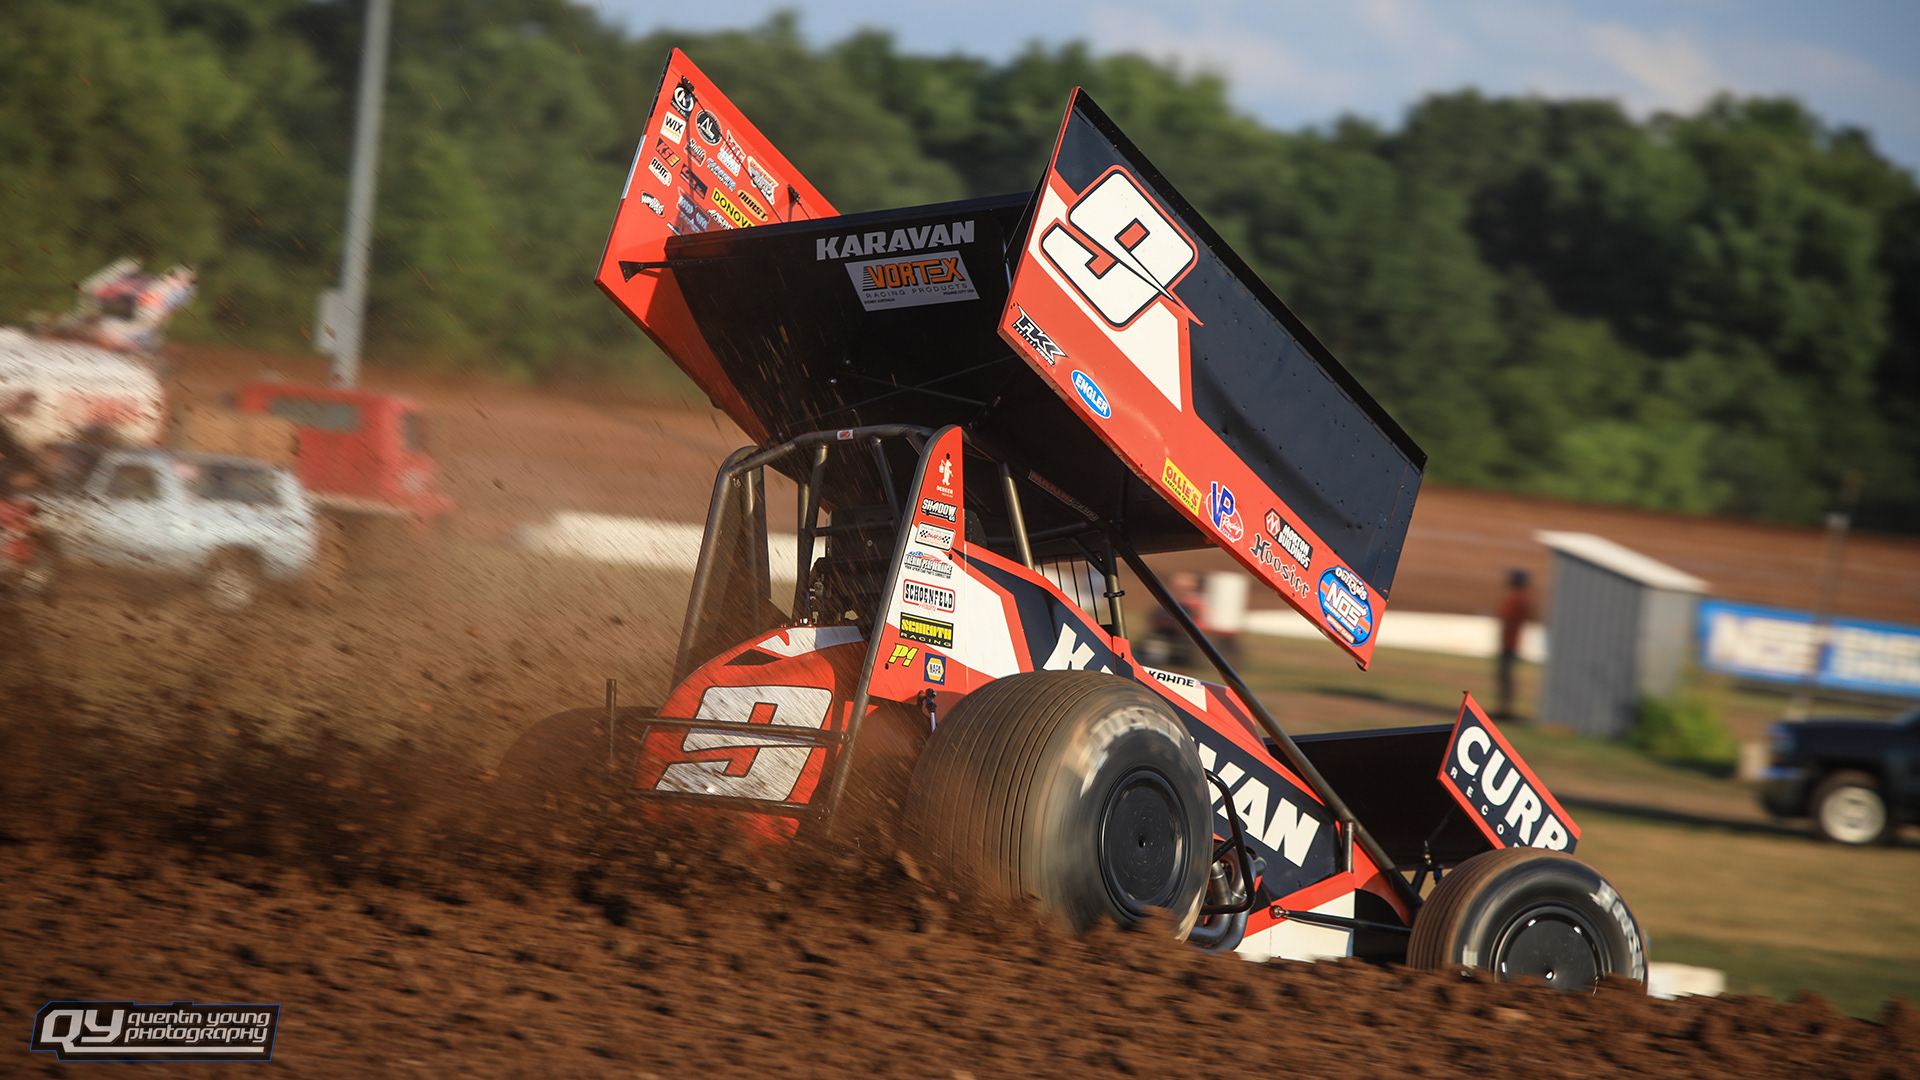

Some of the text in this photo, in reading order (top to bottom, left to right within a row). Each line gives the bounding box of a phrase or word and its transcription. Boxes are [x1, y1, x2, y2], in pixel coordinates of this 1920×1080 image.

[665, 116, 683, 134] WIX
[656, 142, 680, 167] KSE
[816, 220, 975, 261] KARAVAN
[1040, 168, 1198, 329] 9
[864, 257, 966, 291] VORTEX
[865, 283, 968, 299] RACING PRODUCTS
[1075, 373, 1109, 416] ENGLER
[922, 498, 957, 517] SHADOW
[1212, 482, 1235, 529] VP
[1278, 531, 1311, 569] BUILDINGS
[1282, 524, 1310, 556] MORTON
[1249, 533, 1310, 599] Hoosier
[905, 583, 953, 609] SCHOENFELD
[1325, 580, 1368, 628] NOS
[901, 619, 952, 641] SCHROTH
[901, 632, 952, 647] RACING
[929, 663, 942, 676] NAPA
[1147, 670, 1195, 688] KAHNE
[655, 685, 833, 801] 9
